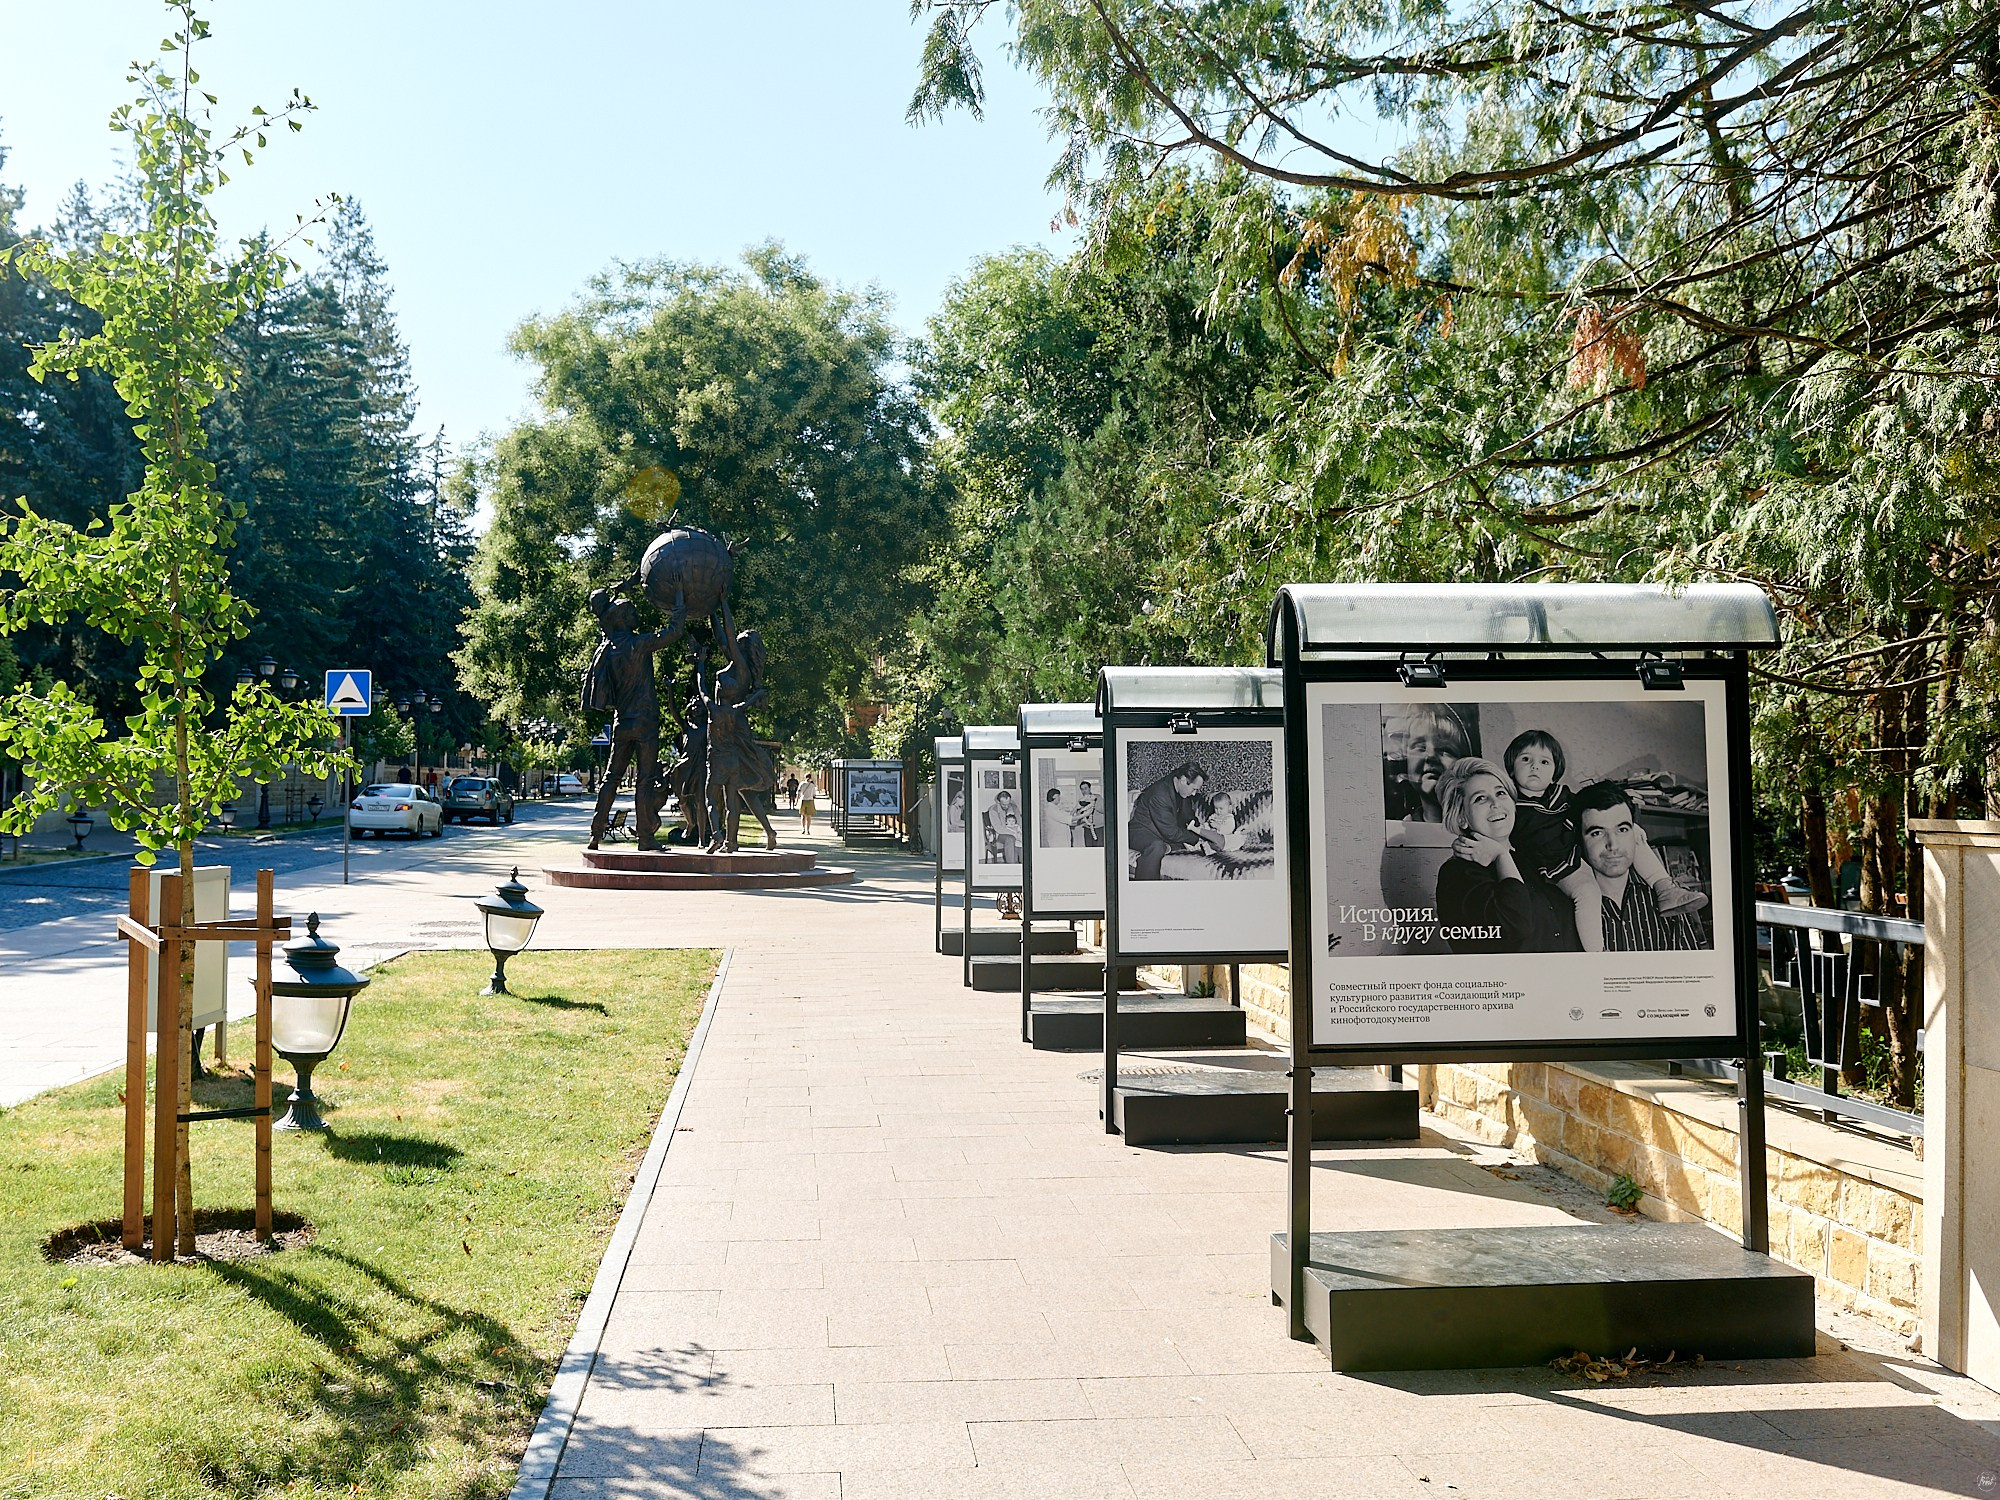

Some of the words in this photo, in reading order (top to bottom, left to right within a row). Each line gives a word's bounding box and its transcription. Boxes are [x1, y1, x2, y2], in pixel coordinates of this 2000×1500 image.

[1339, 905, 1439, 927] История.
[1363, 924, 1377, 941] В
[1381, 926, 1436, 945] кругу
[1439, 925, 1502, 940] семьи
[1329, 982, 1387, 991] Совместный
[1389, 982, 1421, 992] проект
[1423, 980, 1453, 991] фонда
[1454, 980, 1508, 989] социально-
[1329, 993, 1388, 1003] культурного
[1389, 992, 1433, 1002] развития
[1434, 990, 1500, 1000] «Созидающий
[1501, 991, 1526, 1000] мир»
[1338, 1004, 1396, 1014] Российского
[1398, 1003, 1480, 1013] государственного
[1482, 1002, 1514, 1012] архива
[1330, 1014, 1431, 1025] кинофотодокументов
